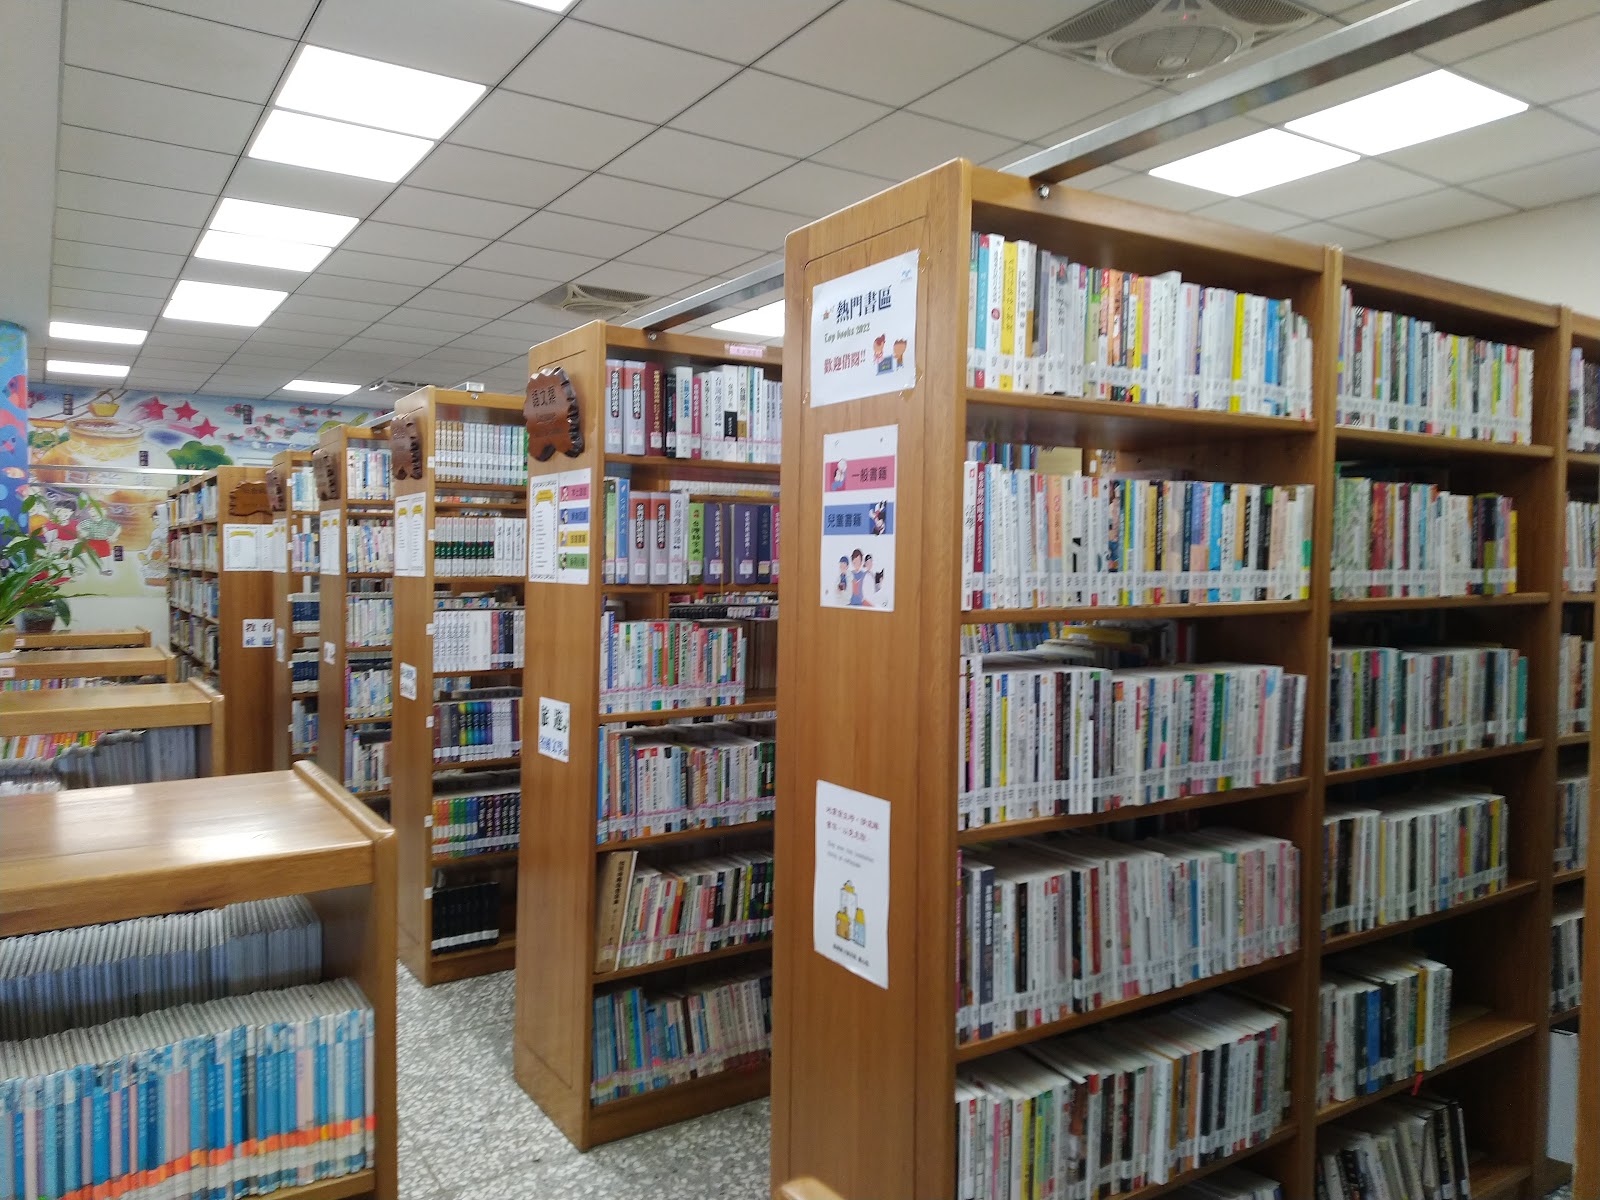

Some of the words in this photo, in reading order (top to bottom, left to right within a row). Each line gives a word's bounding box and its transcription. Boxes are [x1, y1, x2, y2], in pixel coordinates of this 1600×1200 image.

[836, 285, 892, 324] 熱門書區
[836, 327, 854, 340] books
[852, 467, 886, 482] 一般書籍
[827, 514, 861, 528] 兒童書籍
